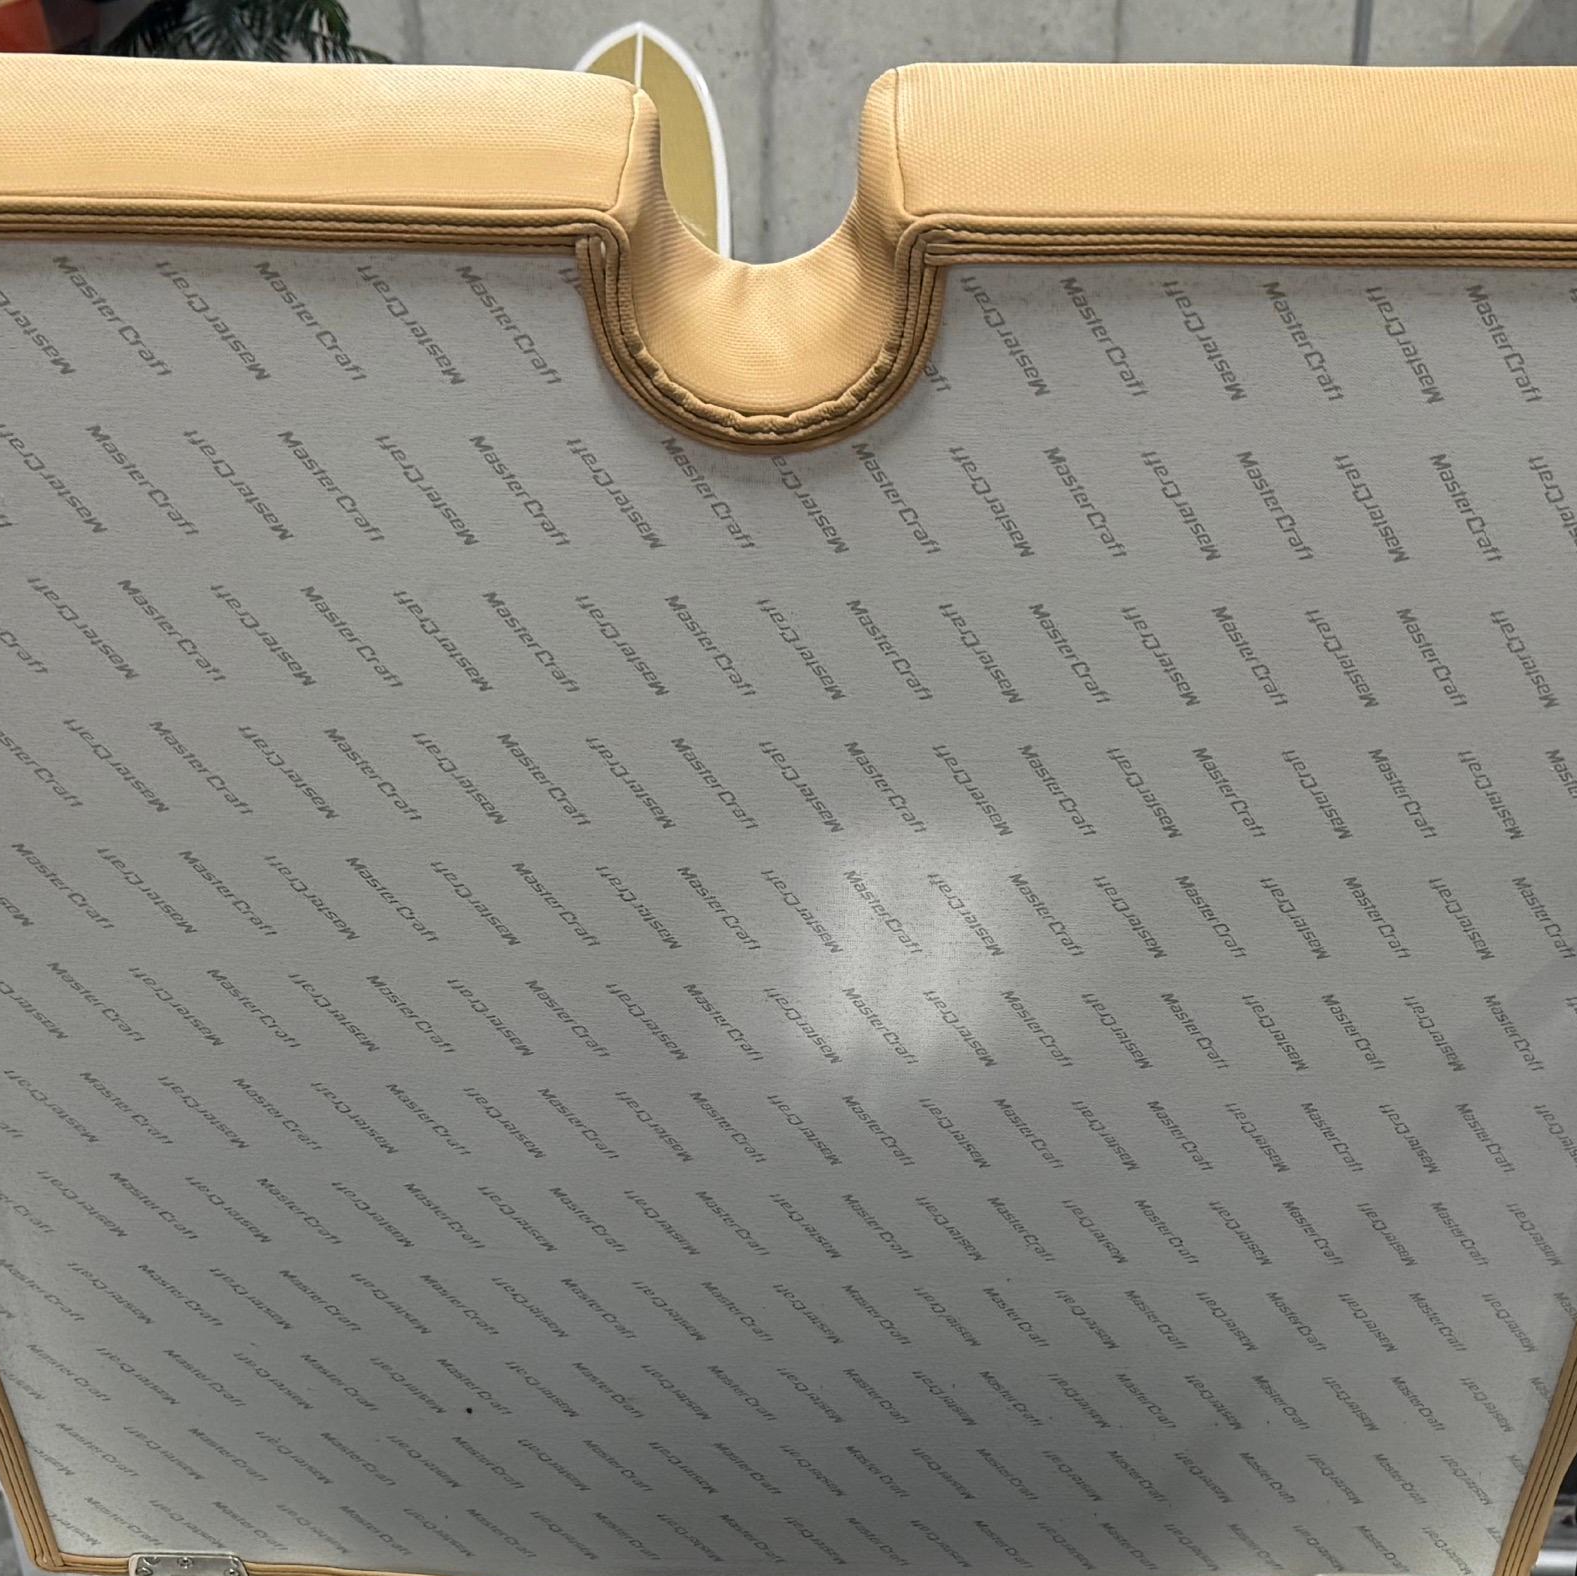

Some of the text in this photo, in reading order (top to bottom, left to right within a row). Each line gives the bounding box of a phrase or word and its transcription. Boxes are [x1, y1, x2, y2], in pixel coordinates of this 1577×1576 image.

[1261, 280, 1346, 403] MasterCraft
[84, 423, 201, 537] MasterCraft
[276, 429, 386, 543] MasterCraft
[467, 434, 572, 548] MasterCraft
[947, 445, 1037, 559] MasterCraft
[1234, 449, 1316, 562] MasterCraft
[1427, 452, 1504, 564] MasterCraft
[480, 590, 581, 694] MasterCraft
[1027, 602, 1113, 705] MasterCraft
[1394, 606, 1469, 708] MasterCraft
[61, 717, 171, 814] MasterCraft
[584, 736, 678, 831] MasterCraft
[1190, 746, 1268, 839] MasterCraft
[510, 861, 602, 948] MasterCraft
[1258, 876, 1331, 962] MasterCraft
